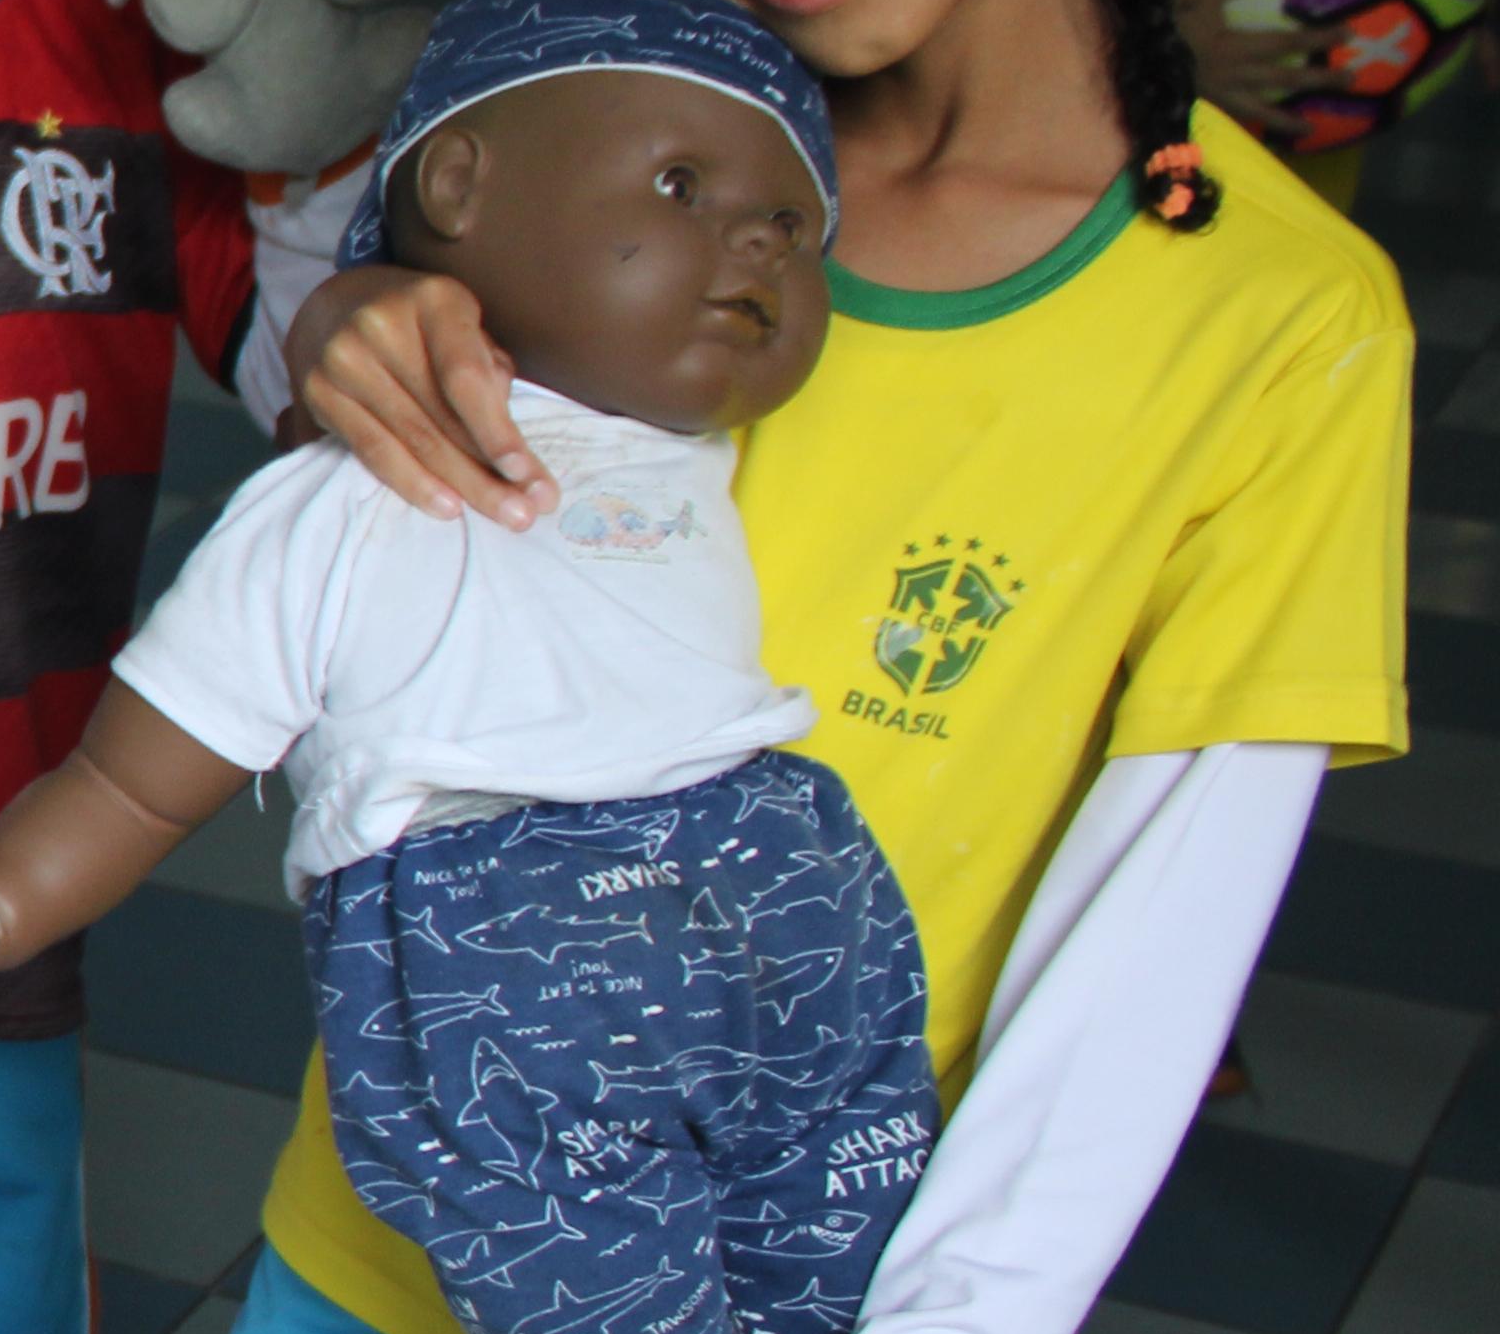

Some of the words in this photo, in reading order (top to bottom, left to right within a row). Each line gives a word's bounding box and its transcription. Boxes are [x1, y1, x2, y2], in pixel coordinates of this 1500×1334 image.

[840, 689, 951, 741] BRASIL
[413, 868, 454, 886] NICE
[477, 856, 500, 875] EA
[575, 859, 683, 903] SHARK!
[537, 981, 573, 1003] EAT
[825, 1109, 932, 1165] SHARK
[824, 1147, 931, 1199] ATTAC
